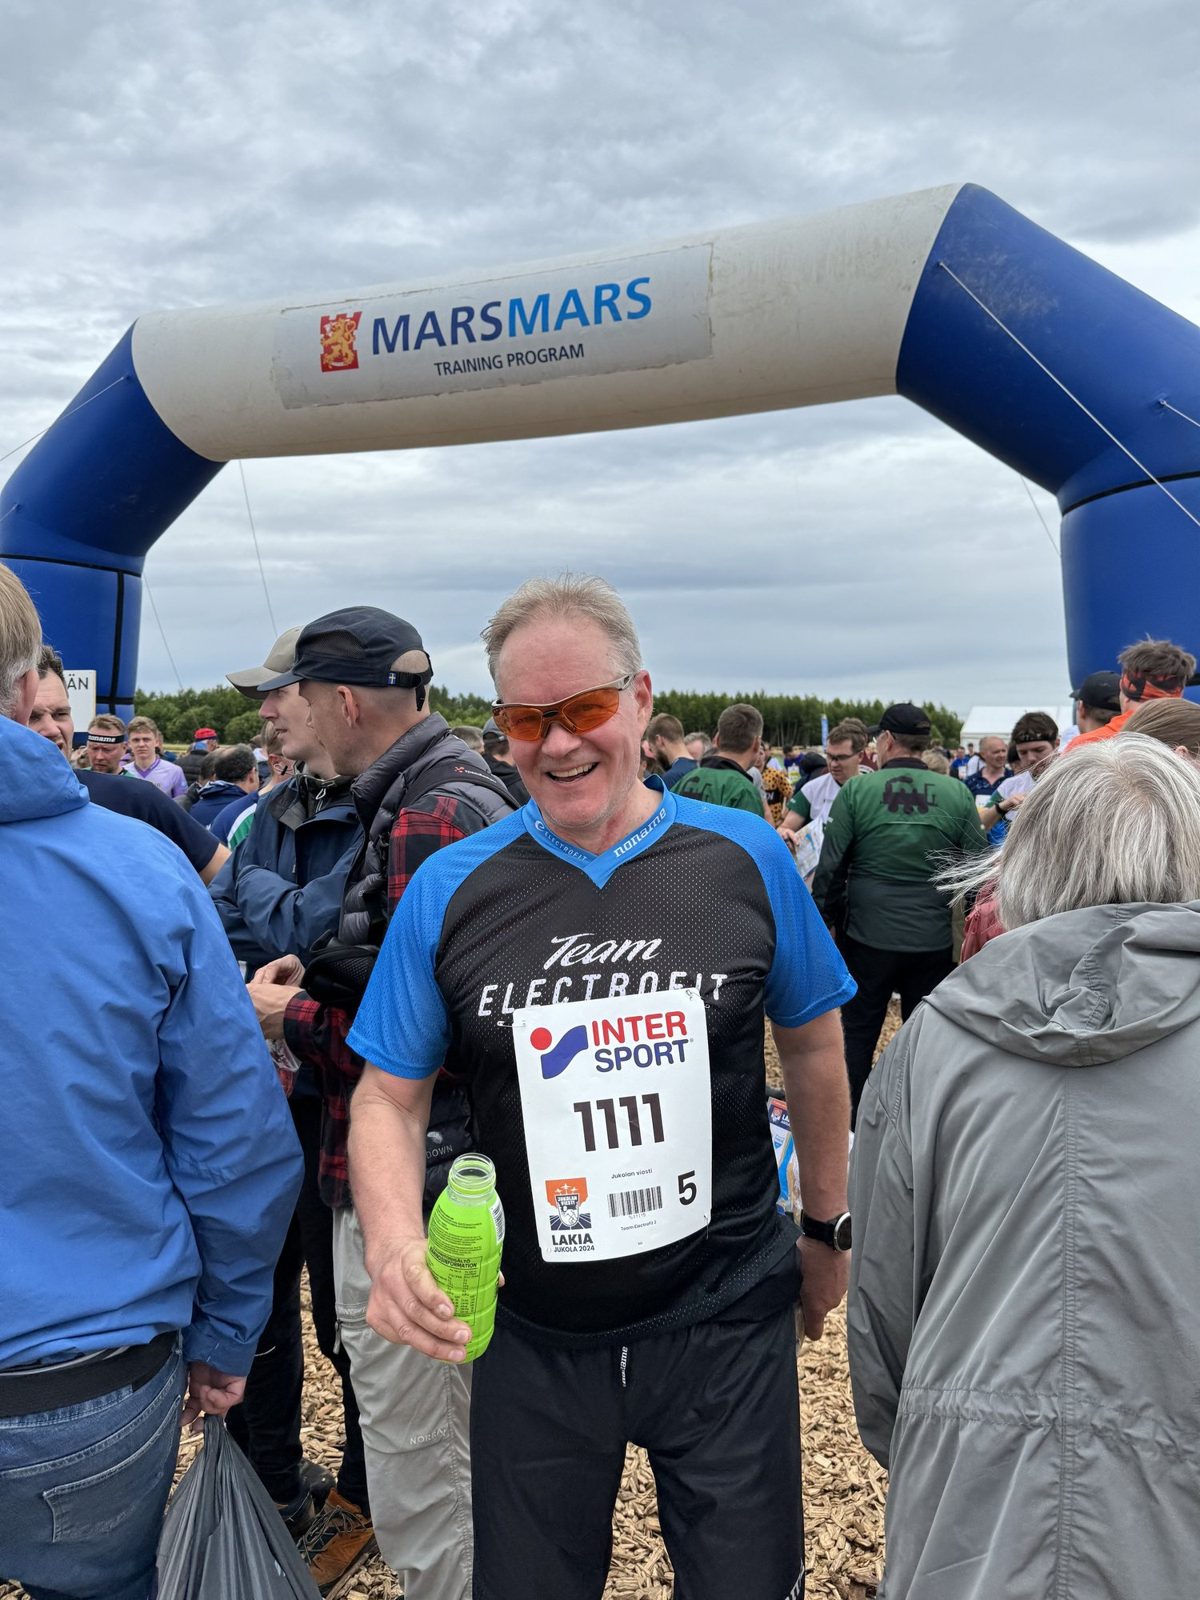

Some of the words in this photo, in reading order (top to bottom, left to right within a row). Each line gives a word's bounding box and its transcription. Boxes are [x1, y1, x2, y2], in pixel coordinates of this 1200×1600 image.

[434, 354, 504, 377] TRAINING
[506, 343, 585, 368] PROGRAM
[613, 807, 667, 858] noname
[543, 933, 662, 970] Team
[478, 971, 728, 1016] ELECTROFIT
[591, 1011, 688, 1046] INTER
[594, 1038, 689, 1073] SPORT
[573, 1093, 665, 1152] 1111
[677, 1170, 697, 1206] 5
[551, 1233, 594, 1246] LAKIA
[578, 1244, 595, 1252] 2024
